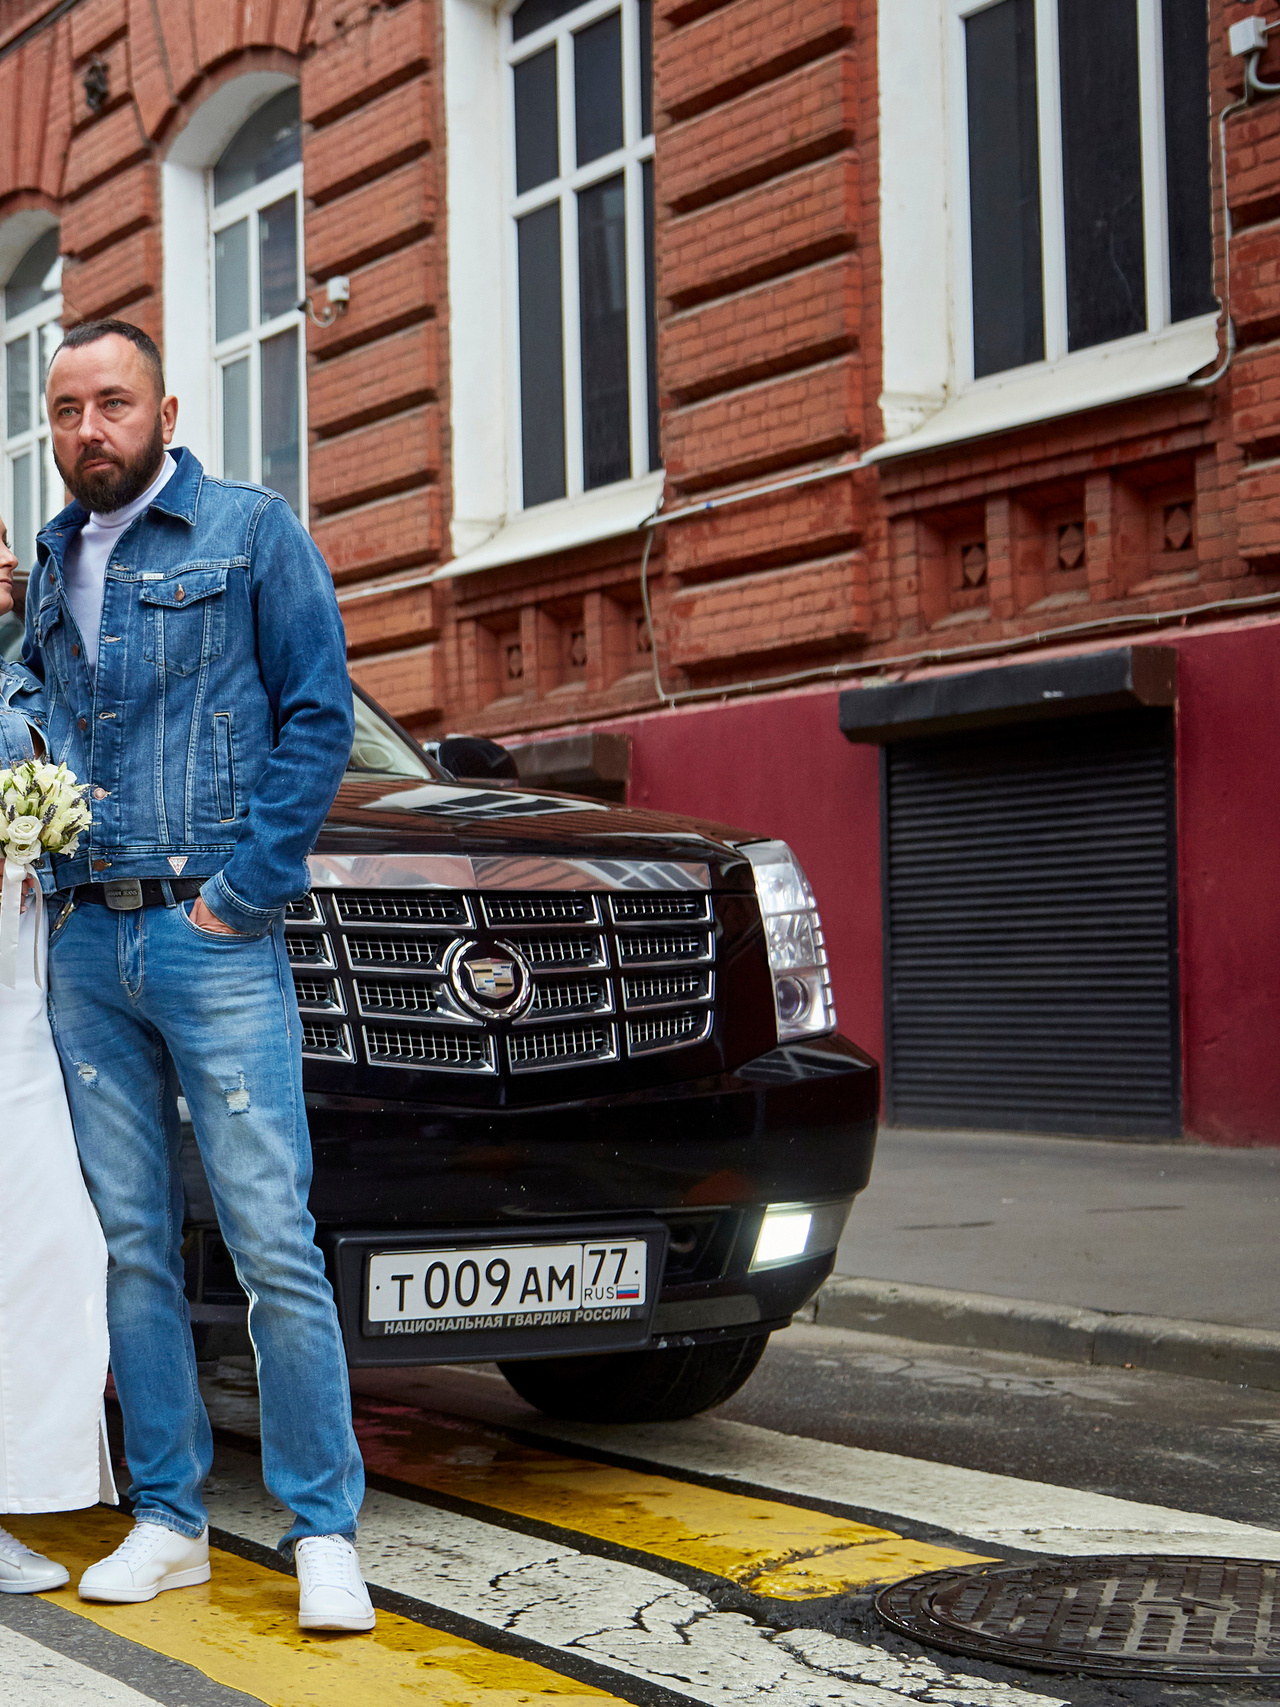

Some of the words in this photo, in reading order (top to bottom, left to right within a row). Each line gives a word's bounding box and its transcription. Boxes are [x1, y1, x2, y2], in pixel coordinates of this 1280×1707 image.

[588, 1247, 628, 1286] 77
[584, 1286, 615, 1301] RUS
[384, 1315, 503, 1335] НАЦИОНАЛЬНАЯ
[507, 1310, 571, 1327] ГВАРДИЯ
[574, 1307, 631, 1322] РОССИИ
